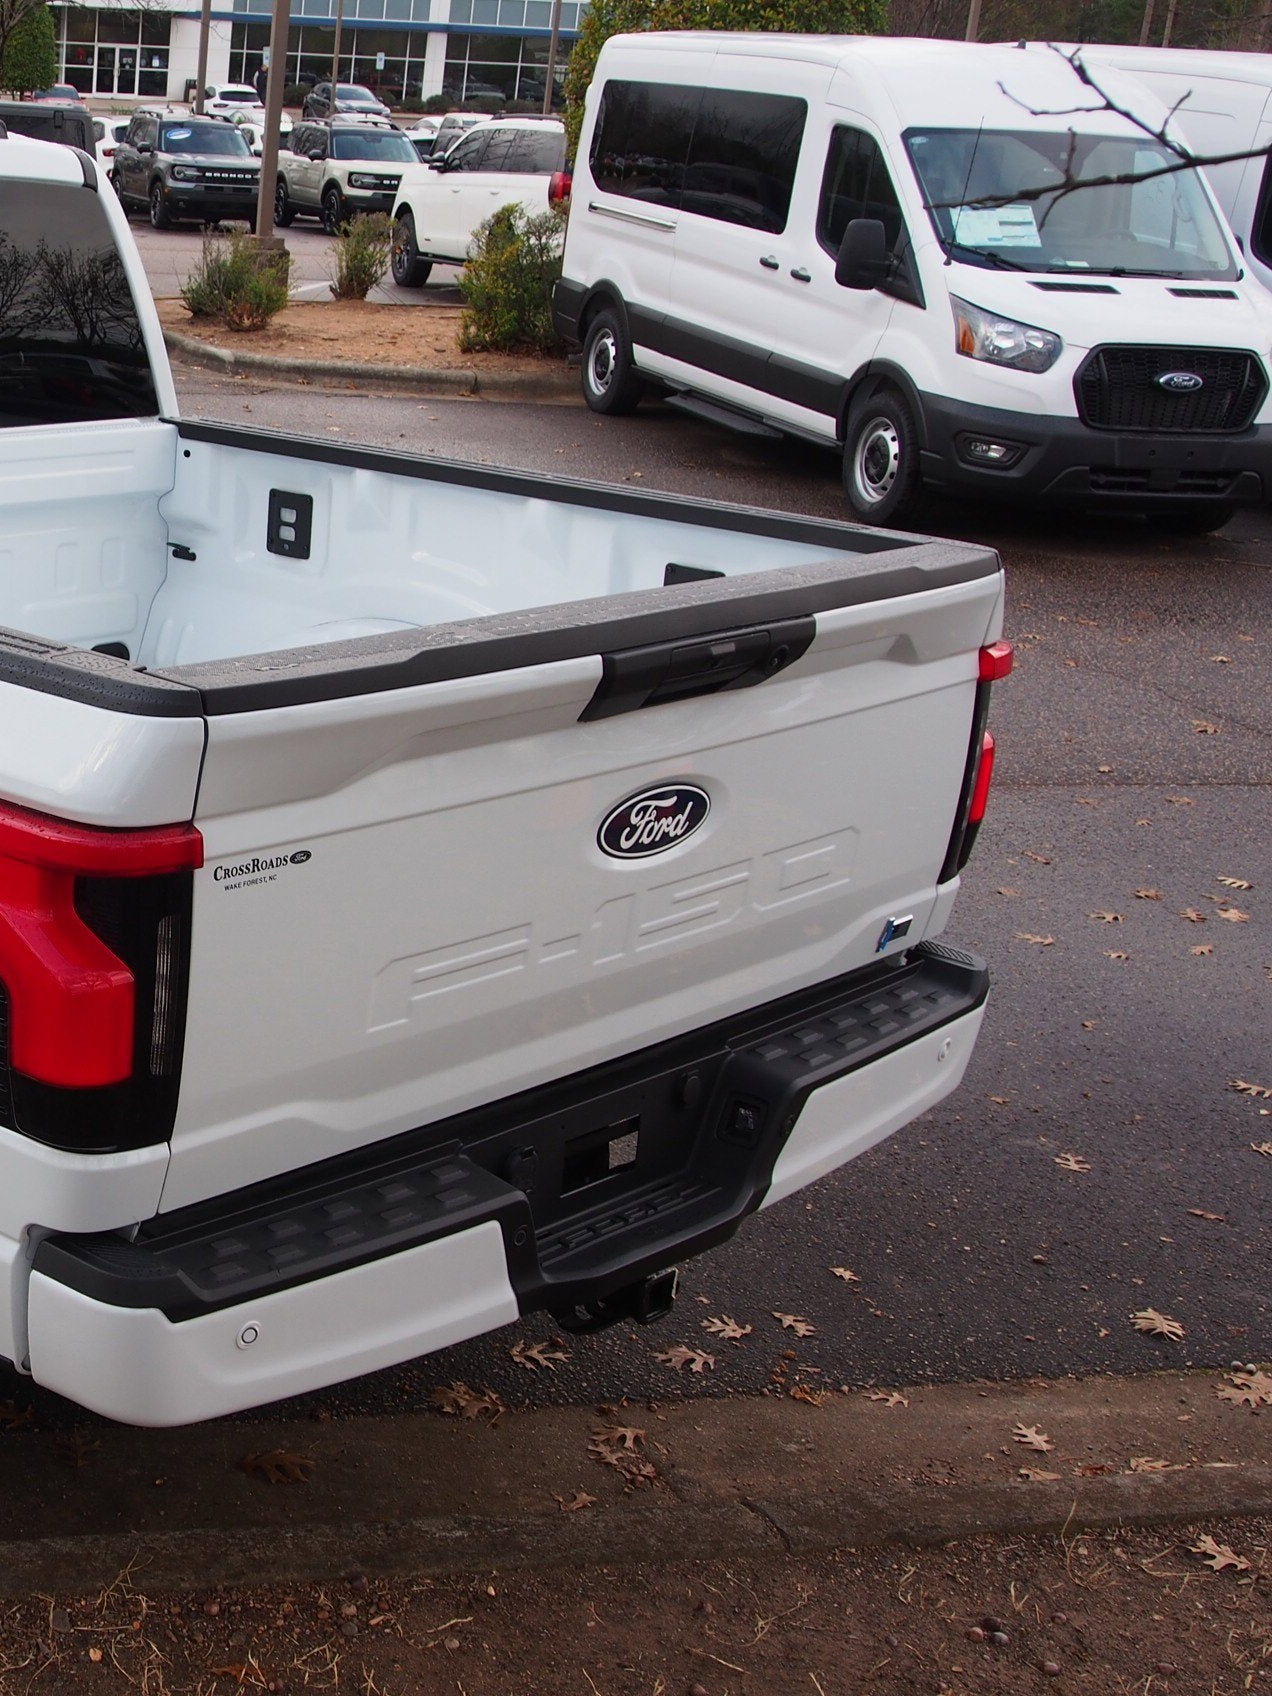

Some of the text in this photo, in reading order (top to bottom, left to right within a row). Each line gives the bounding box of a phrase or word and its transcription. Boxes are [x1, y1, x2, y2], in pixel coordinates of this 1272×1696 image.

[620, 795, 694, 850] Ford
[224, 874, 278, 892] WAKE FOREST, NC
[366, 826, 861, 1034] F-150
